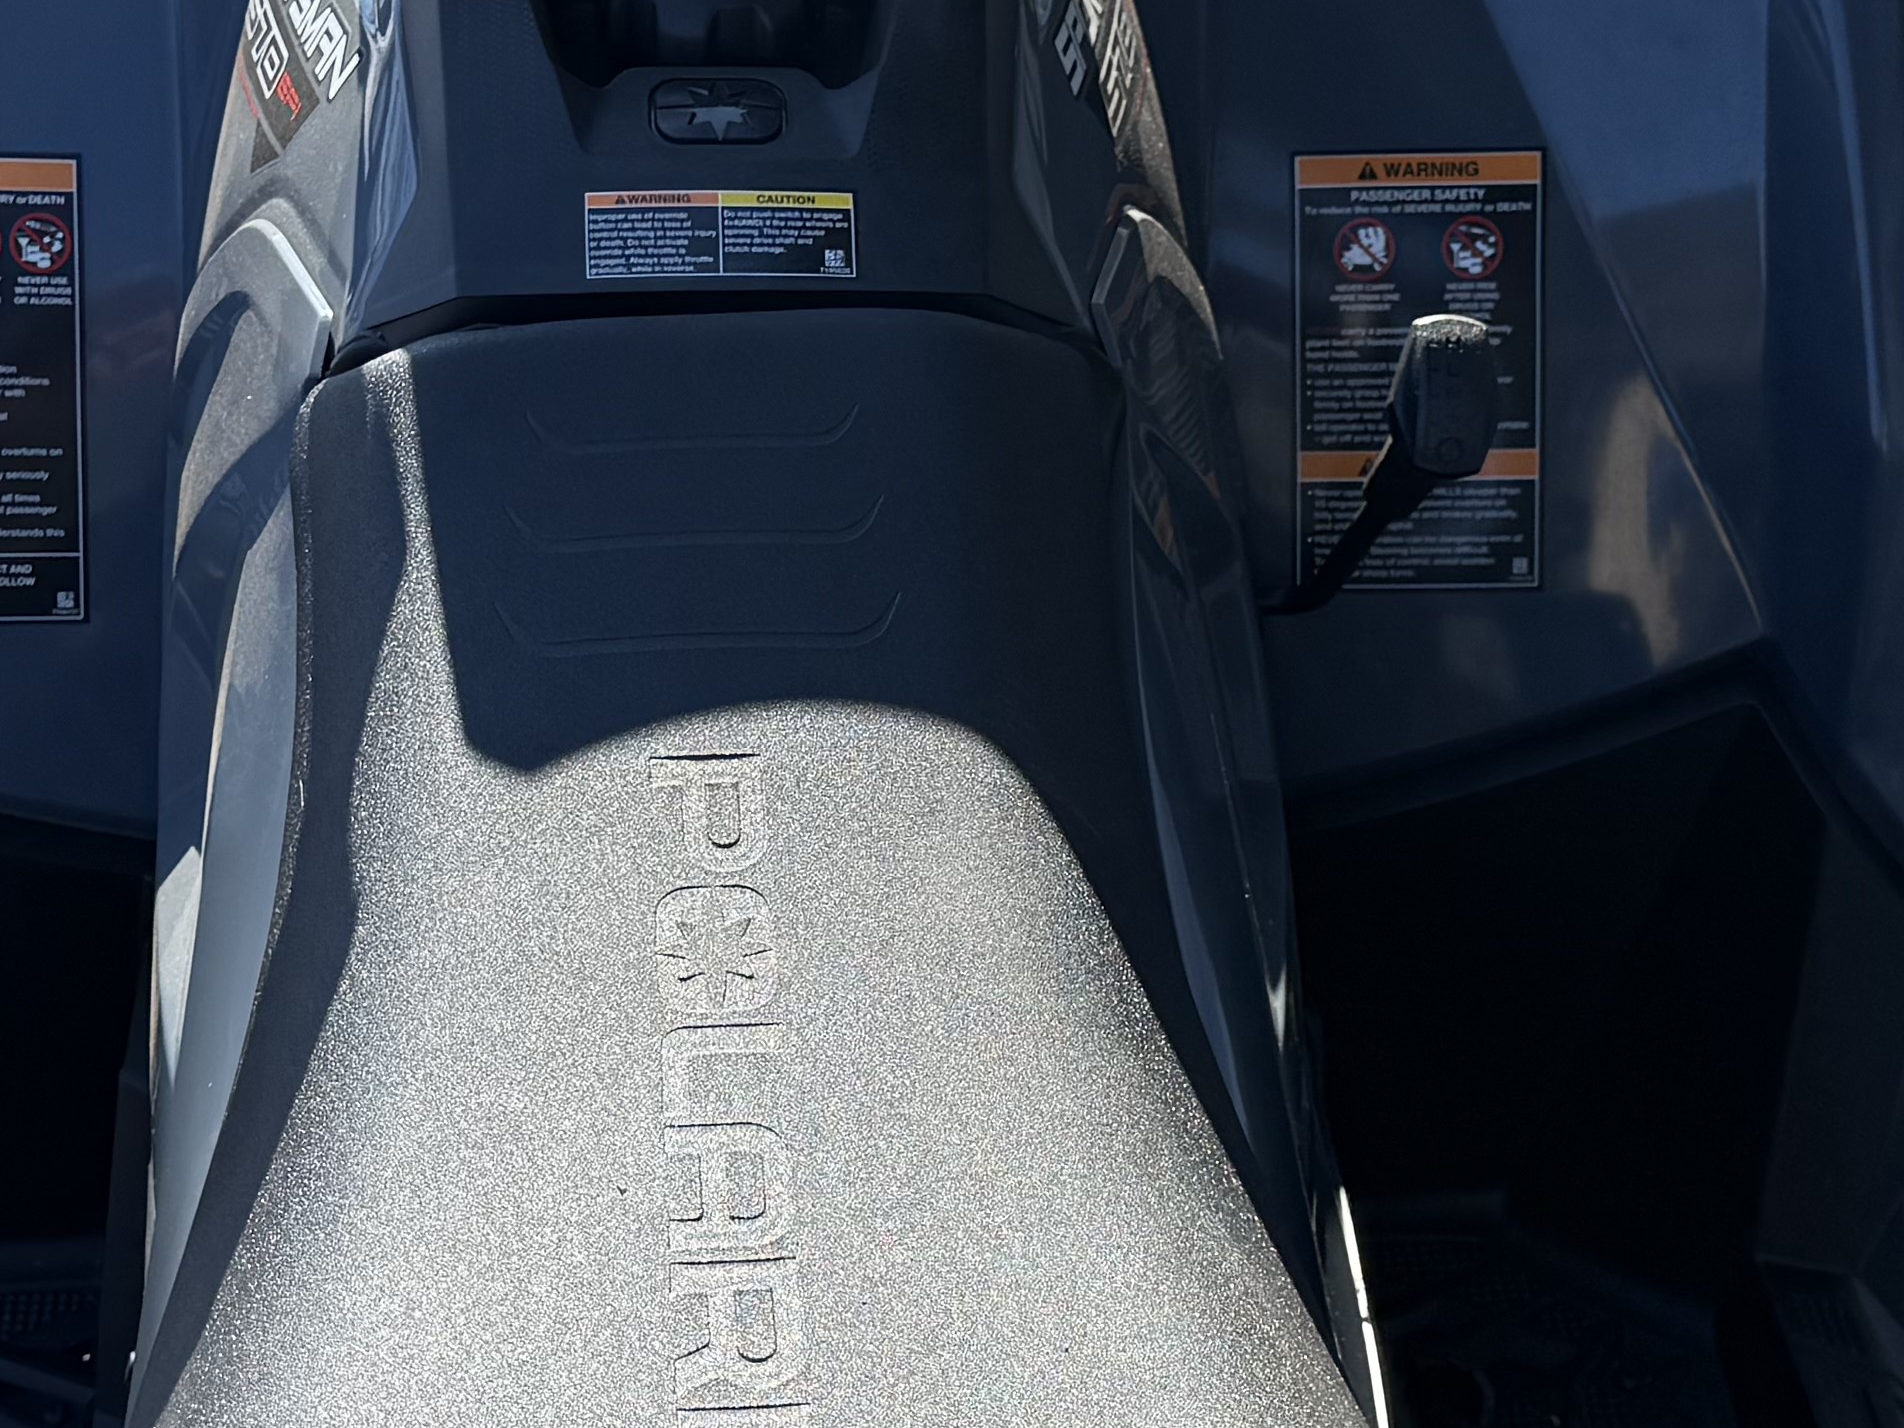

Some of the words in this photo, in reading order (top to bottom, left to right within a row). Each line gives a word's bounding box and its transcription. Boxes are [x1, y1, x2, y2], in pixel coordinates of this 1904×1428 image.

[1383, 161, 1479, 178] WARNING
[626, 194, 692, 204] WARNING
[756, 194, 816, 205] CAUTION
[1350, 189, 1431, 202] PASSENGER
[1434, 188, 1484, 200] SAFETY
